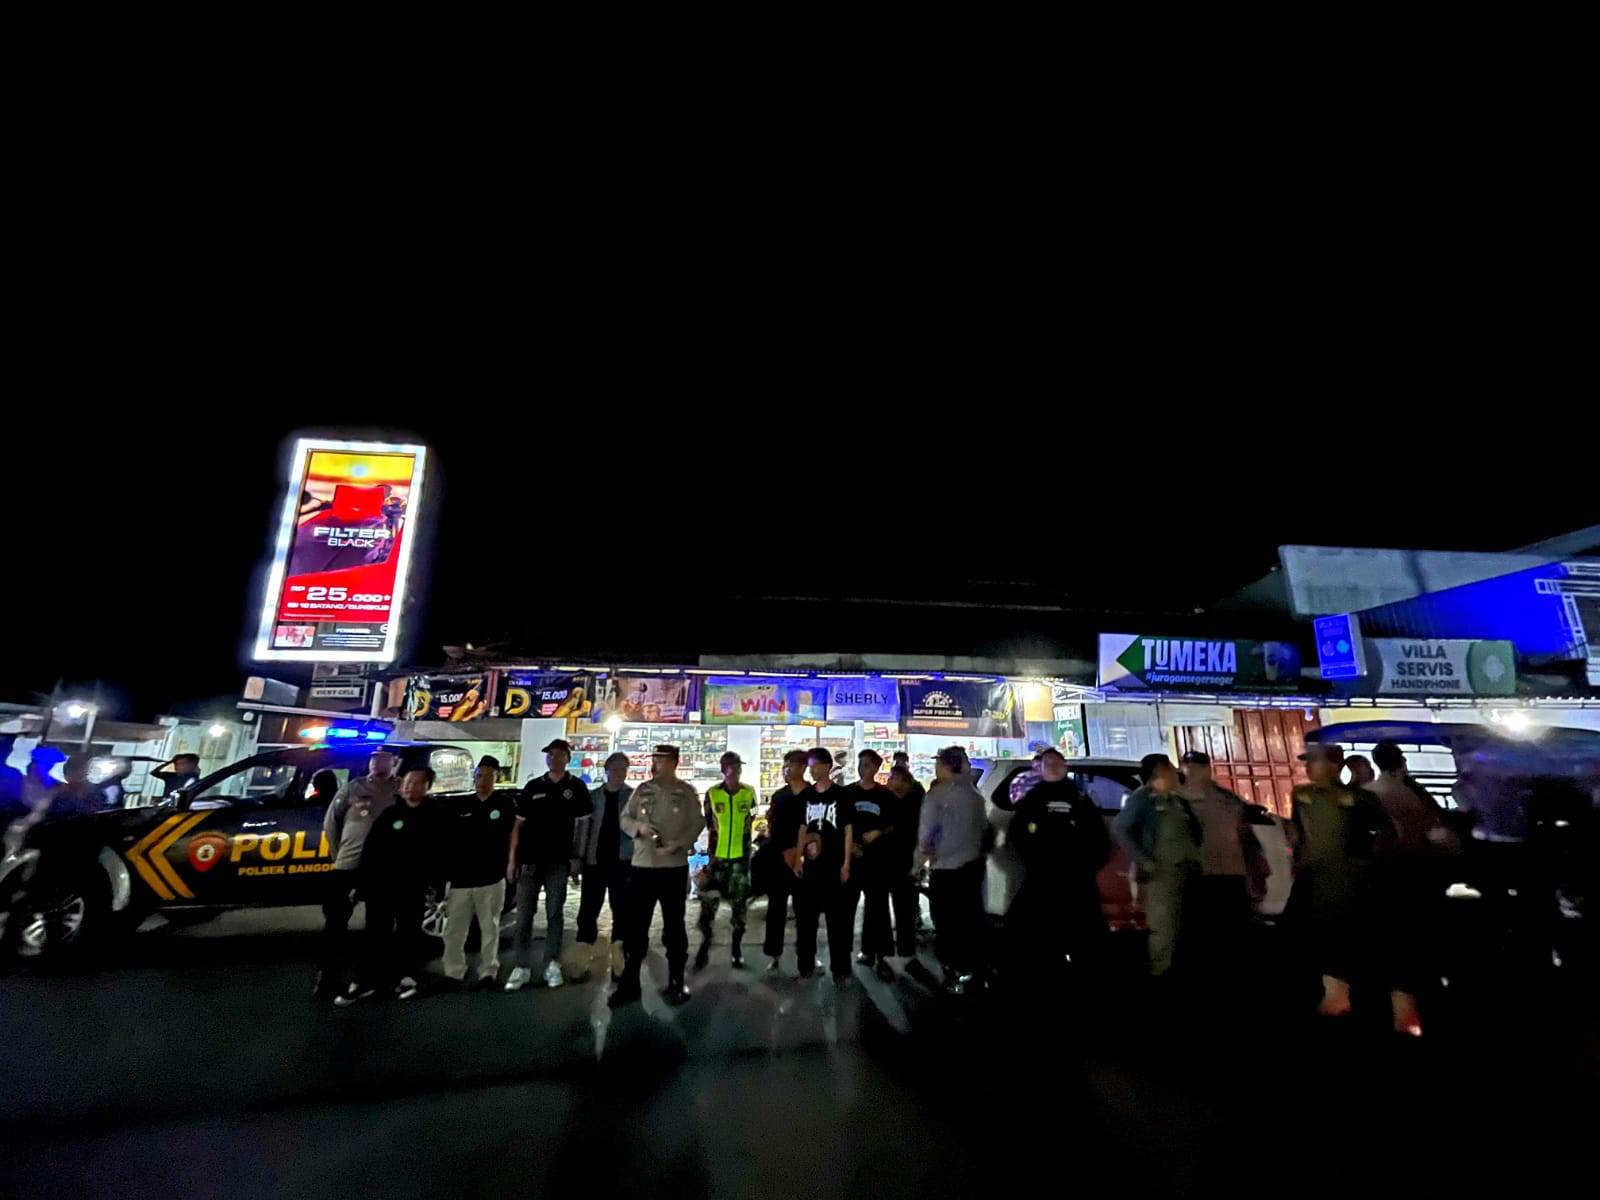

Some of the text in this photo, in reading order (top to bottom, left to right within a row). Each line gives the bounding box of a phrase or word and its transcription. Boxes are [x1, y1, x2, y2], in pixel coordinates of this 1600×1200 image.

[313, 527, 391, 539] FILTER
[327, 538, 375, 548] BLACK
[1142, 639, 1237, 673] TUMEKA
[1401, 644, 1447, 660] VILLA
[1396, 661, 1454, 677] SERVIS
[1391, 679, 1461, 689] HANDPHONE
[542, 690, 568, 701] 15.000
[836, 693, 889, 705] SHERLY
[238, 865, 285, 876] POLSEK
